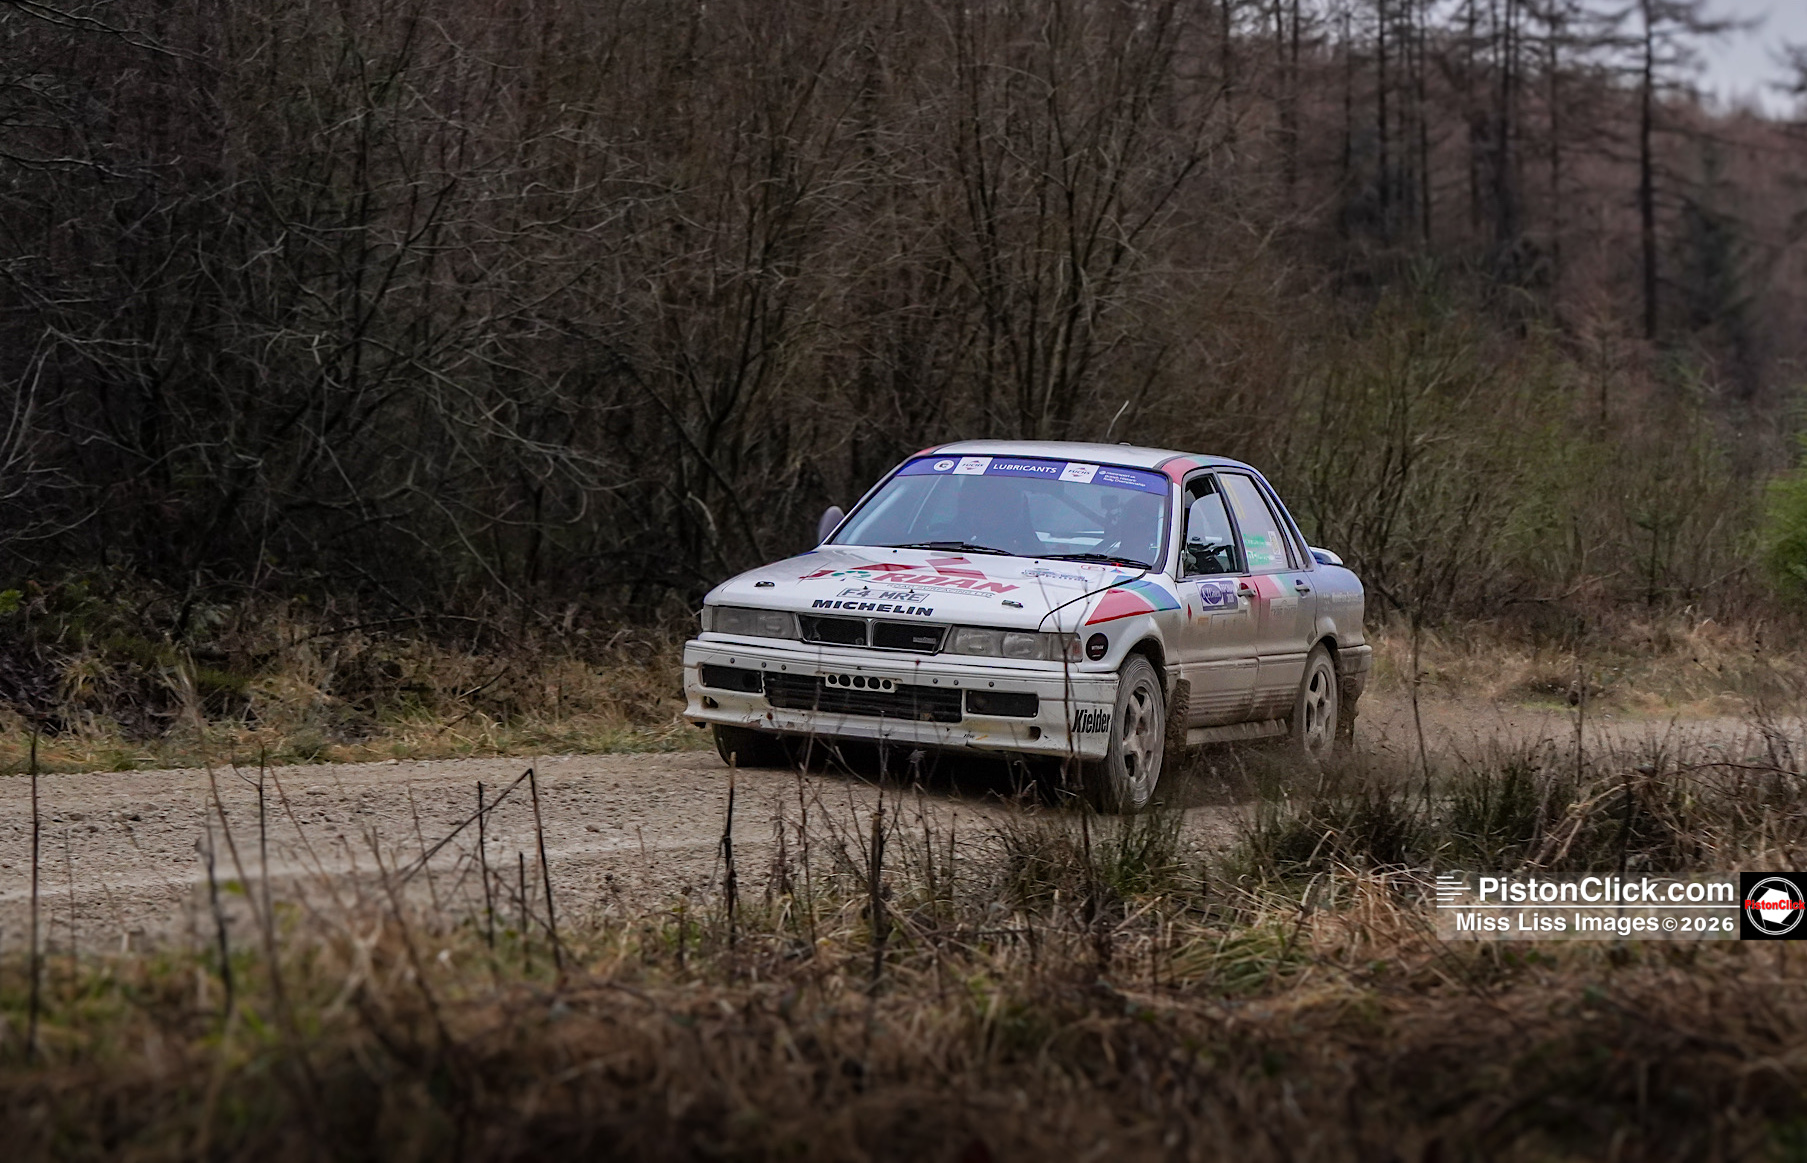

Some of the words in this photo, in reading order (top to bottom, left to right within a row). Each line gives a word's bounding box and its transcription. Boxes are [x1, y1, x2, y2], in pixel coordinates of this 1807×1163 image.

[993, 463, 1057, 474] LUBRICANTS
[841, 588, 869, 597] F4
[879, 591, 921, 601] MRE
[812, 599, 934, 616] MICHELIN
[1071, 709, 1111, 733] Kielder
